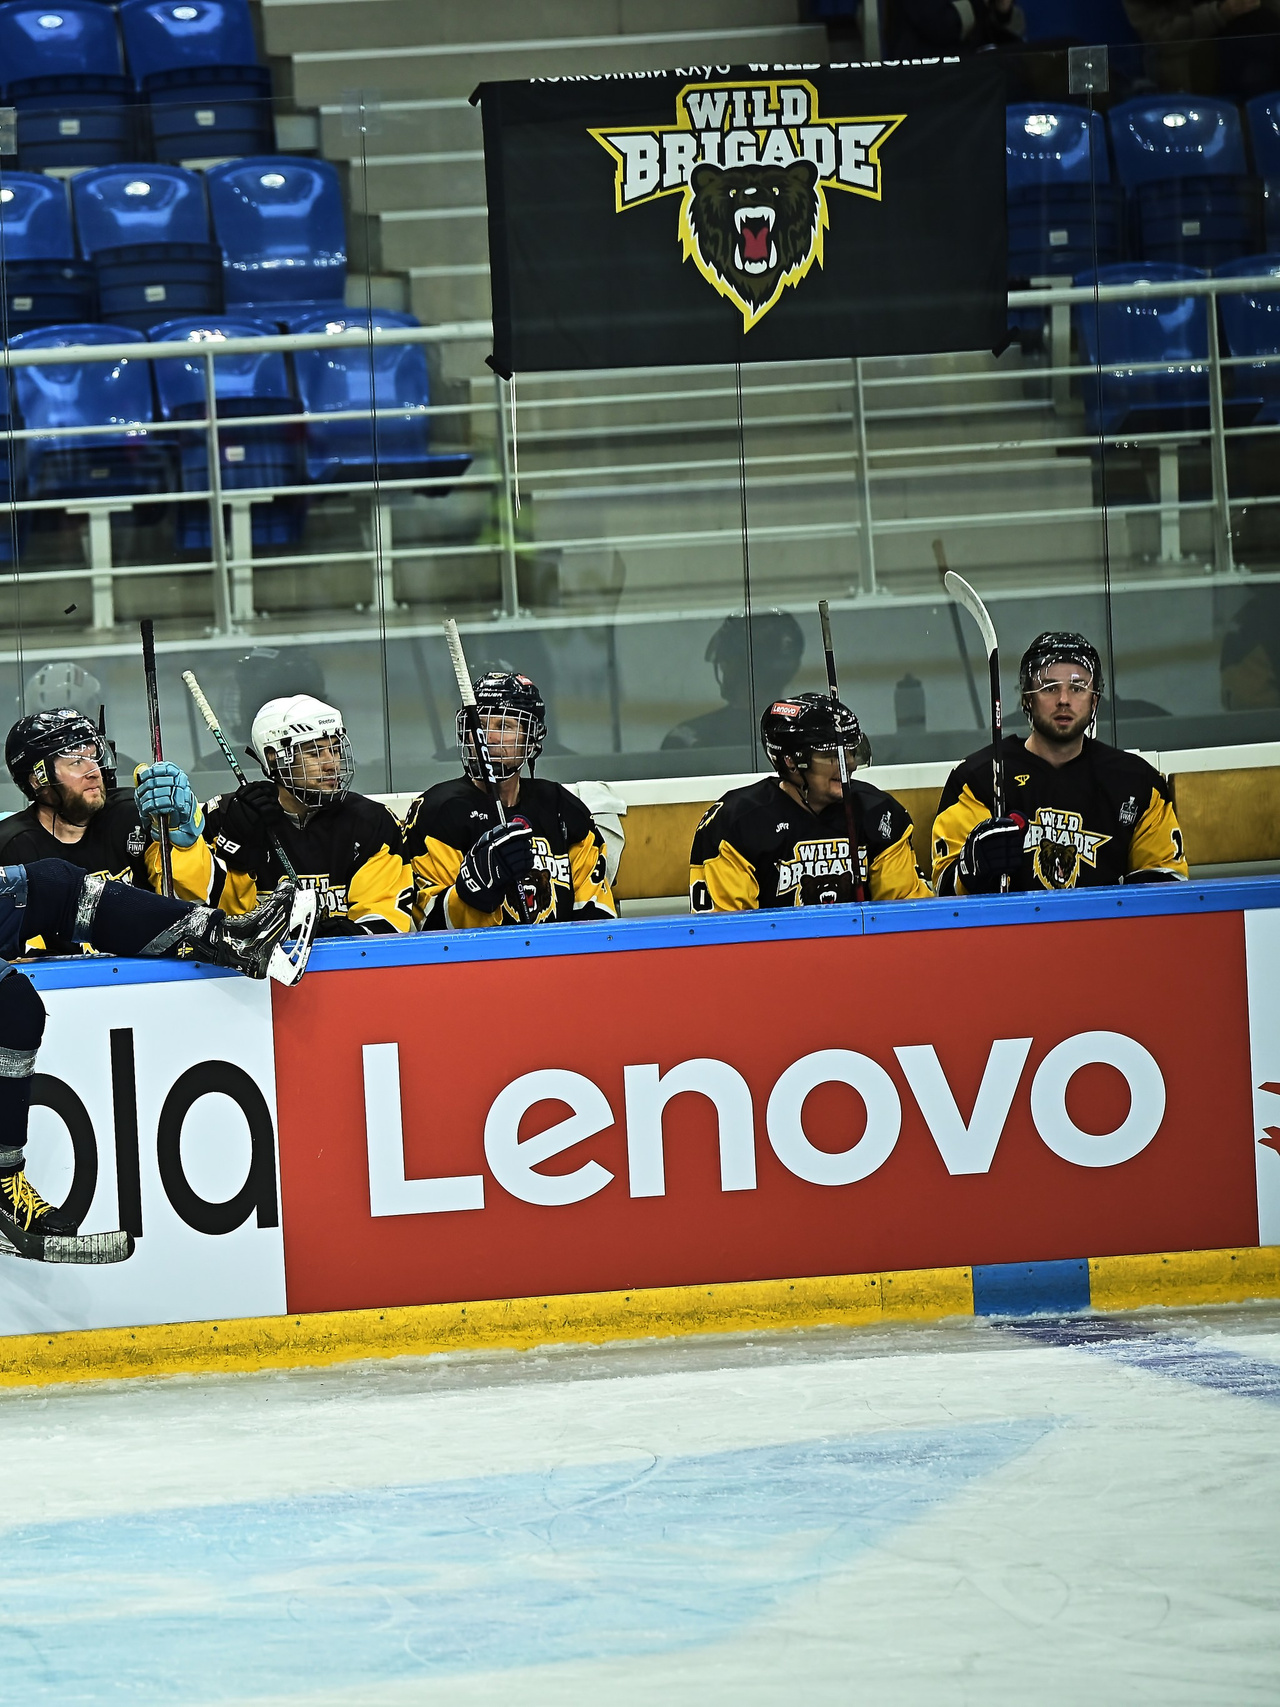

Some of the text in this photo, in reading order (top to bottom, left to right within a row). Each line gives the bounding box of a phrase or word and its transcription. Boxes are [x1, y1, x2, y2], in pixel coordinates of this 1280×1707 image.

[686, 88, 810, 130] WILD
[606, 123, 887, 201] BRIGADE
[772, 704, 797, 715] Lenovo
[475, 727, 497, 784] CCM
[799, 842, 850, 861] WILD
[362, 1030, 1167, 1218] Lenovo
